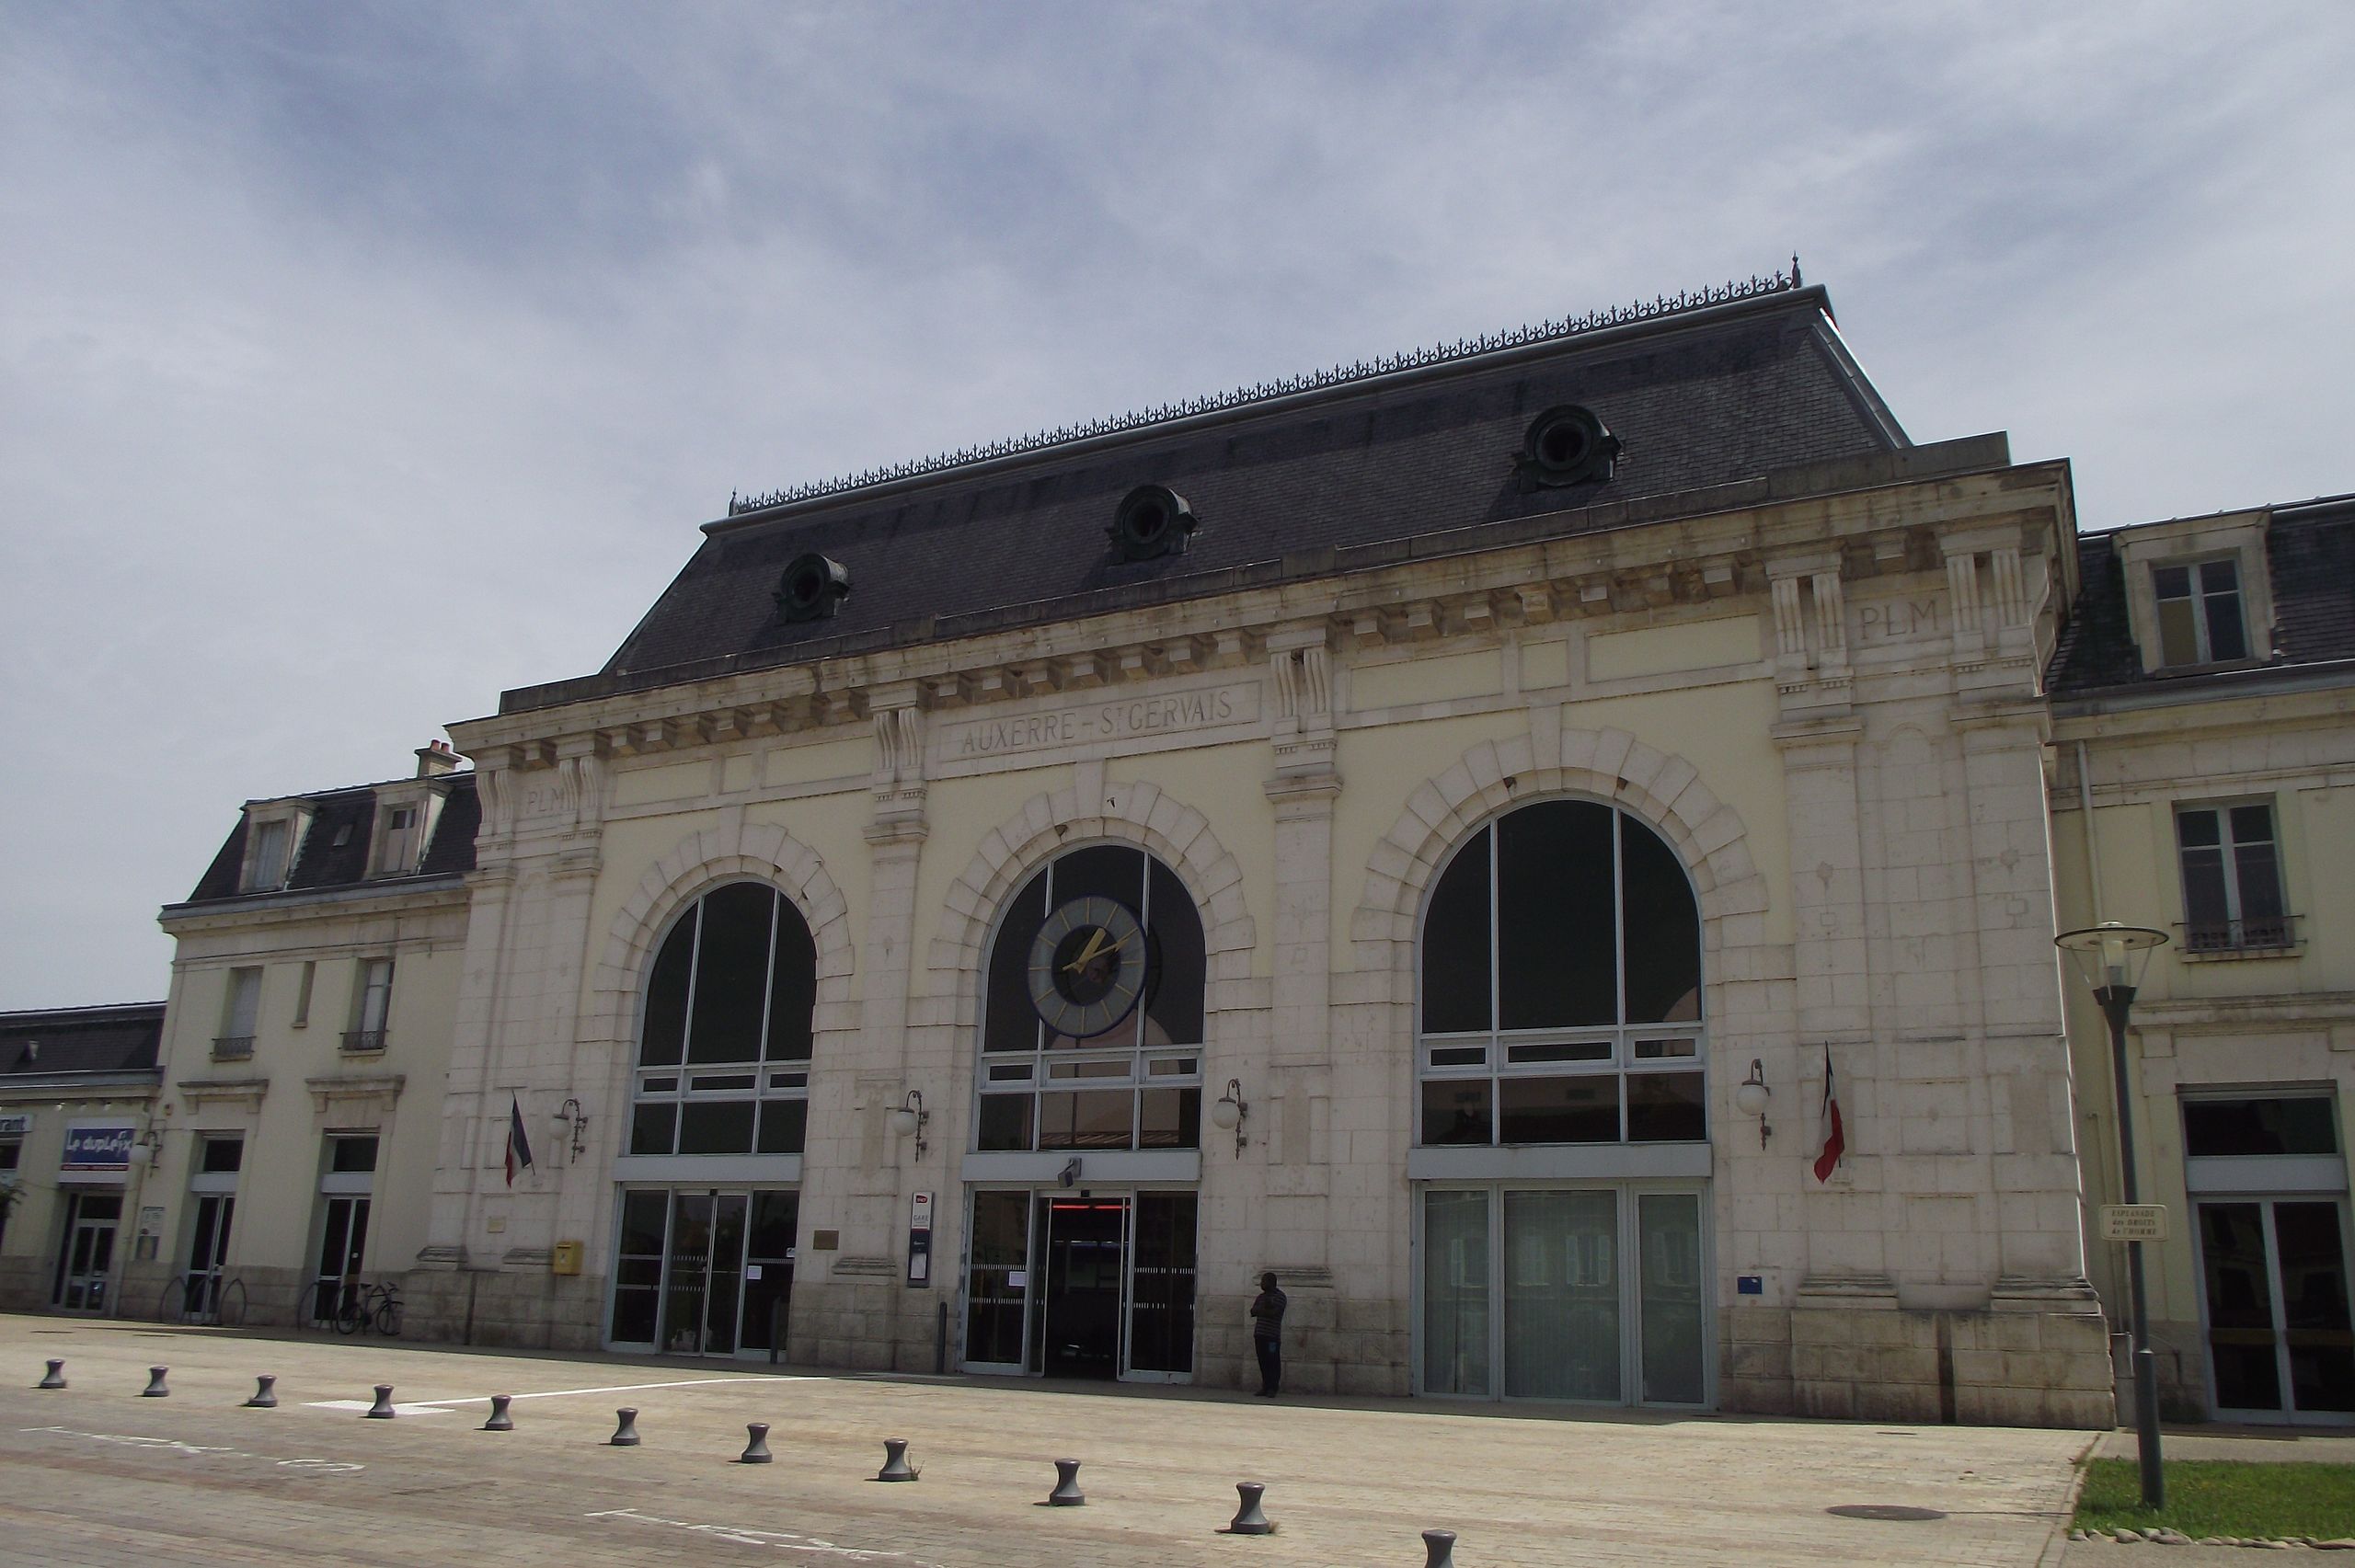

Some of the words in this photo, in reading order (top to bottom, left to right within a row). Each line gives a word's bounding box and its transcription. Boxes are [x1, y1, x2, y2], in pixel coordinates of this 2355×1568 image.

[1859, 600, 1938, 640] PLM
[961, 712, 1077, 754] AUXERRE
[1129, 691, 1233, 731] GERVAIS
[526, 787, 566, 815] PLM
[66, 1127, 80, 1151] Le
